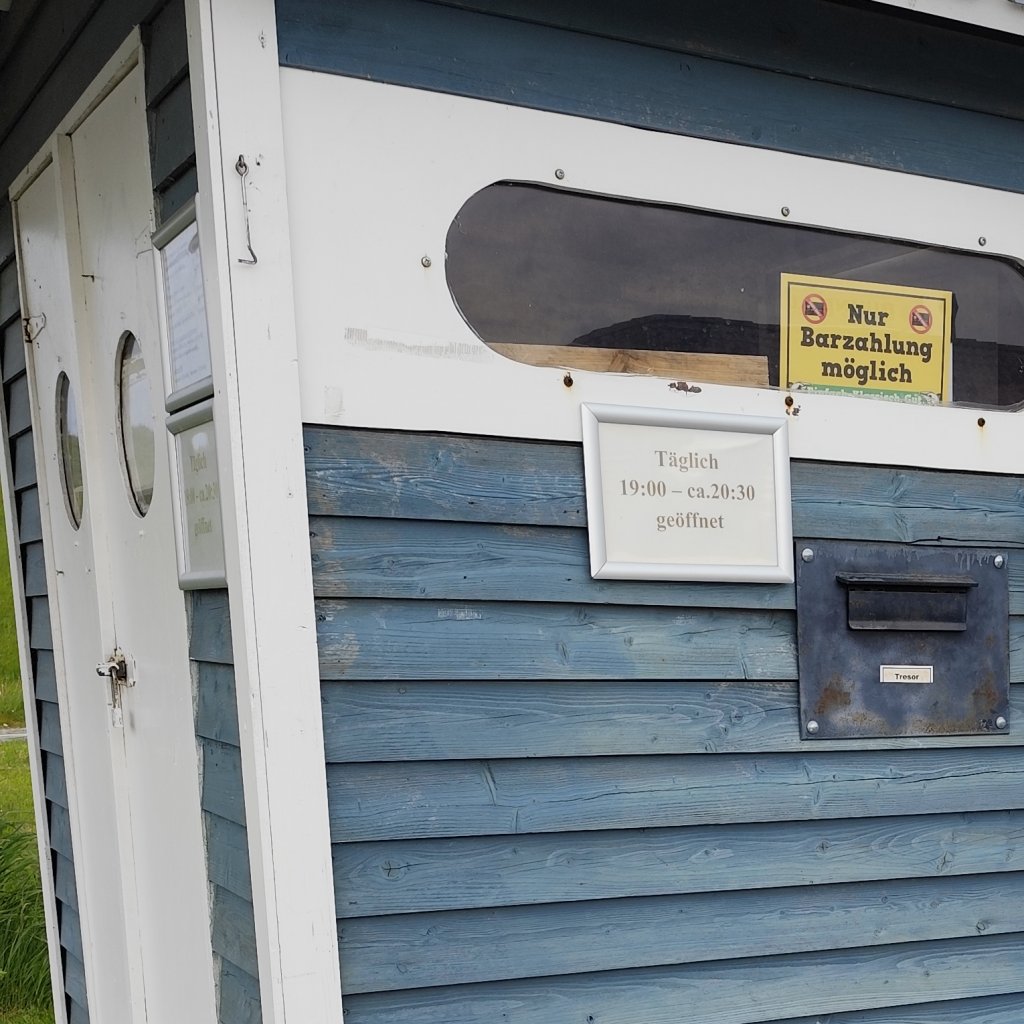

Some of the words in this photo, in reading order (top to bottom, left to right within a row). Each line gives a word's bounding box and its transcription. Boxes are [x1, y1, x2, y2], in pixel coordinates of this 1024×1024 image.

[847, 303, 890, 327] Nur
[800, 326, 933, 363] Barzahlung
[821, 357, 913, 385] möglich
[654, 450, 719, 473] Täglich
[620, 479, 667, 498] 19:00
[687, 483, 756, 501] ca.20:30
[656, 512, 725, 532] geöffnet
